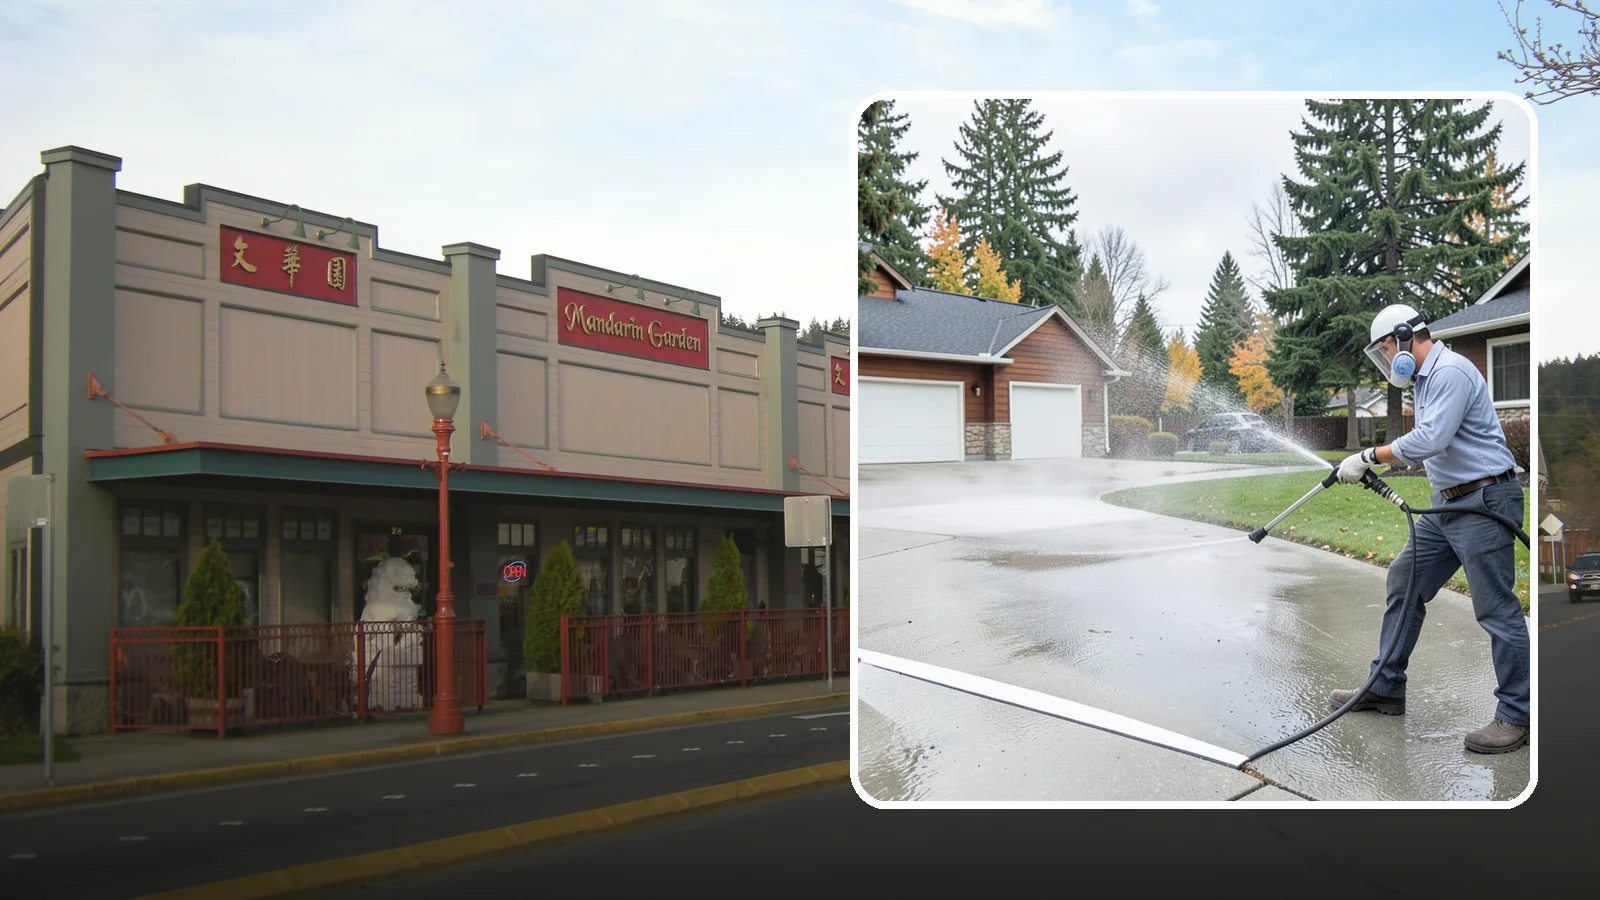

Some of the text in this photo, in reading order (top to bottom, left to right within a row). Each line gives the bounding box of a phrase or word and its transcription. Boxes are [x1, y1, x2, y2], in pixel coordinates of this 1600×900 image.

[231, 236, 346, 291] 文華園
[564, 302, 701, 352] Mandarin Garden
[503, 565, 527, 578] OPEN
